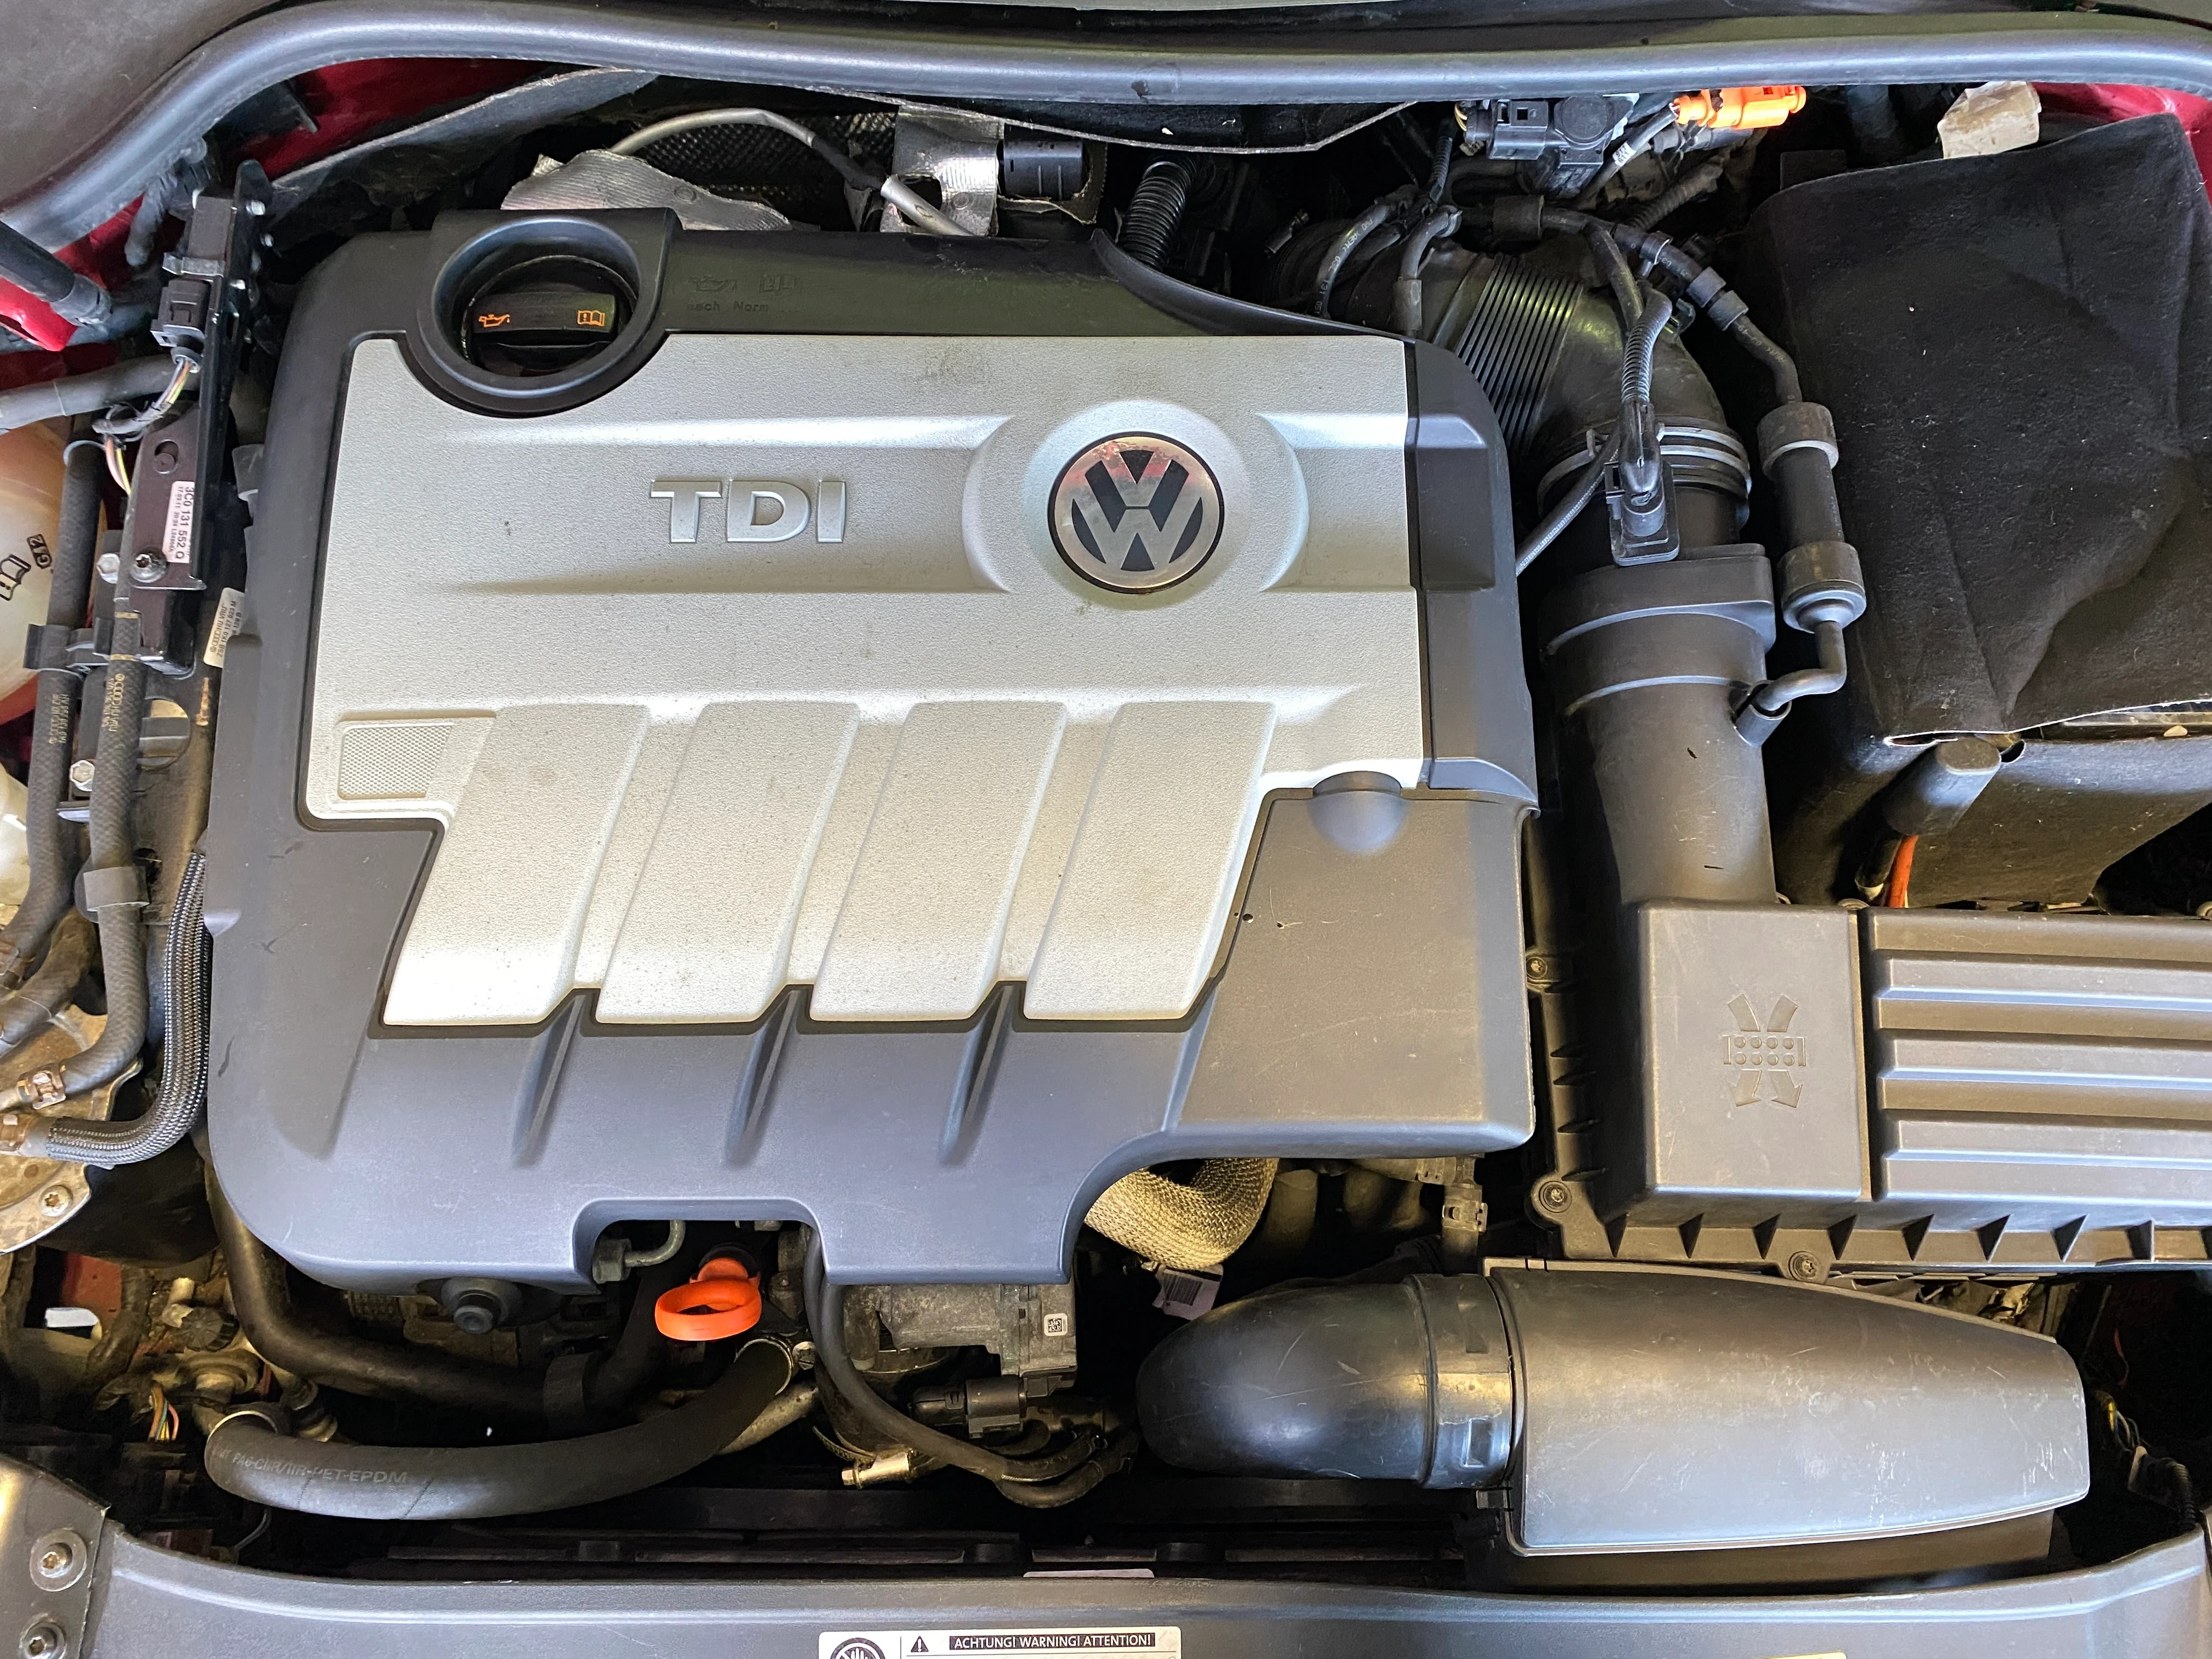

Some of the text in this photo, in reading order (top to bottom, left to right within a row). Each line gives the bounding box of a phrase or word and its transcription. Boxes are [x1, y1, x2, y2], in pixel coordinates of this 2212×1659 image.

[180, 510, 190, 526] 131
[651, 478, 847, 544] TDI
[177, 531, 188, 548] 552
[953, 1634, 1151, 1649] ACHTUNG! WARNING! ATTENTION!
